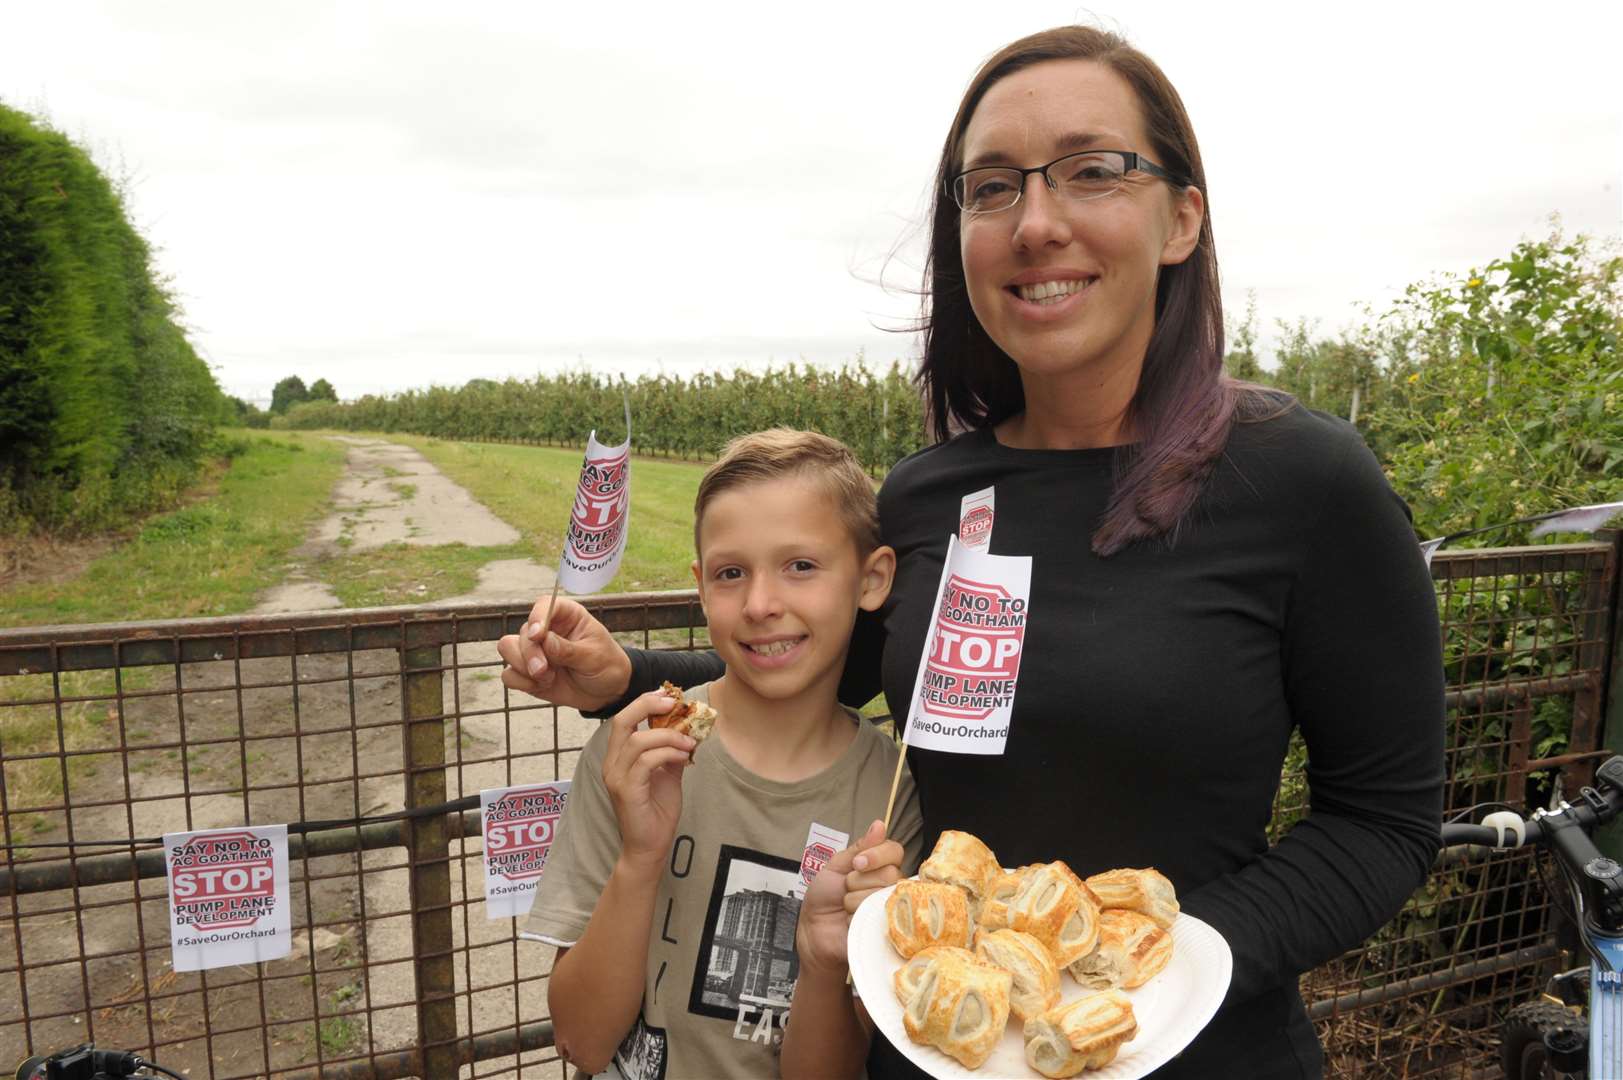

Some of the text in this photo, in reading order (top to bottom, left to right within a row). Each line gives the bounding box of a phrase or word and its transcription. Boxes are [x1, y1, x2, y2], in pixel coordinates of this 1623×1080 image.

[569, 521, 613, 543] UMP
[962, 519, 991, 537] STOP
[959, 591, 991, 612] NO
[1000, 598, 1025, 613] TO
[945, 606, 1024, 627] GOATHAM
[963, 679, 1015, 695] LANE
[487, 800, 517, 813] SAY
[523, 795, 545, 807] NO
[488, 811, 504, 821] AC
[172, 838, 271, 857] SAY NO TO
[173, 849, 273, 866] AC GOATHAM
[489, 852, 530, 866] PUMP
[489, 860, 546, 876] DEVELOP
[174, 866, 273, 897] STOP
[490, 880, 539, 896] #SaveOur
[176, 896, 274, 915] PUMP LANE
[176, 907, 275, 925] DEVELOPMENT
[177, 927, 276, 946] #SaveOurOrchard
